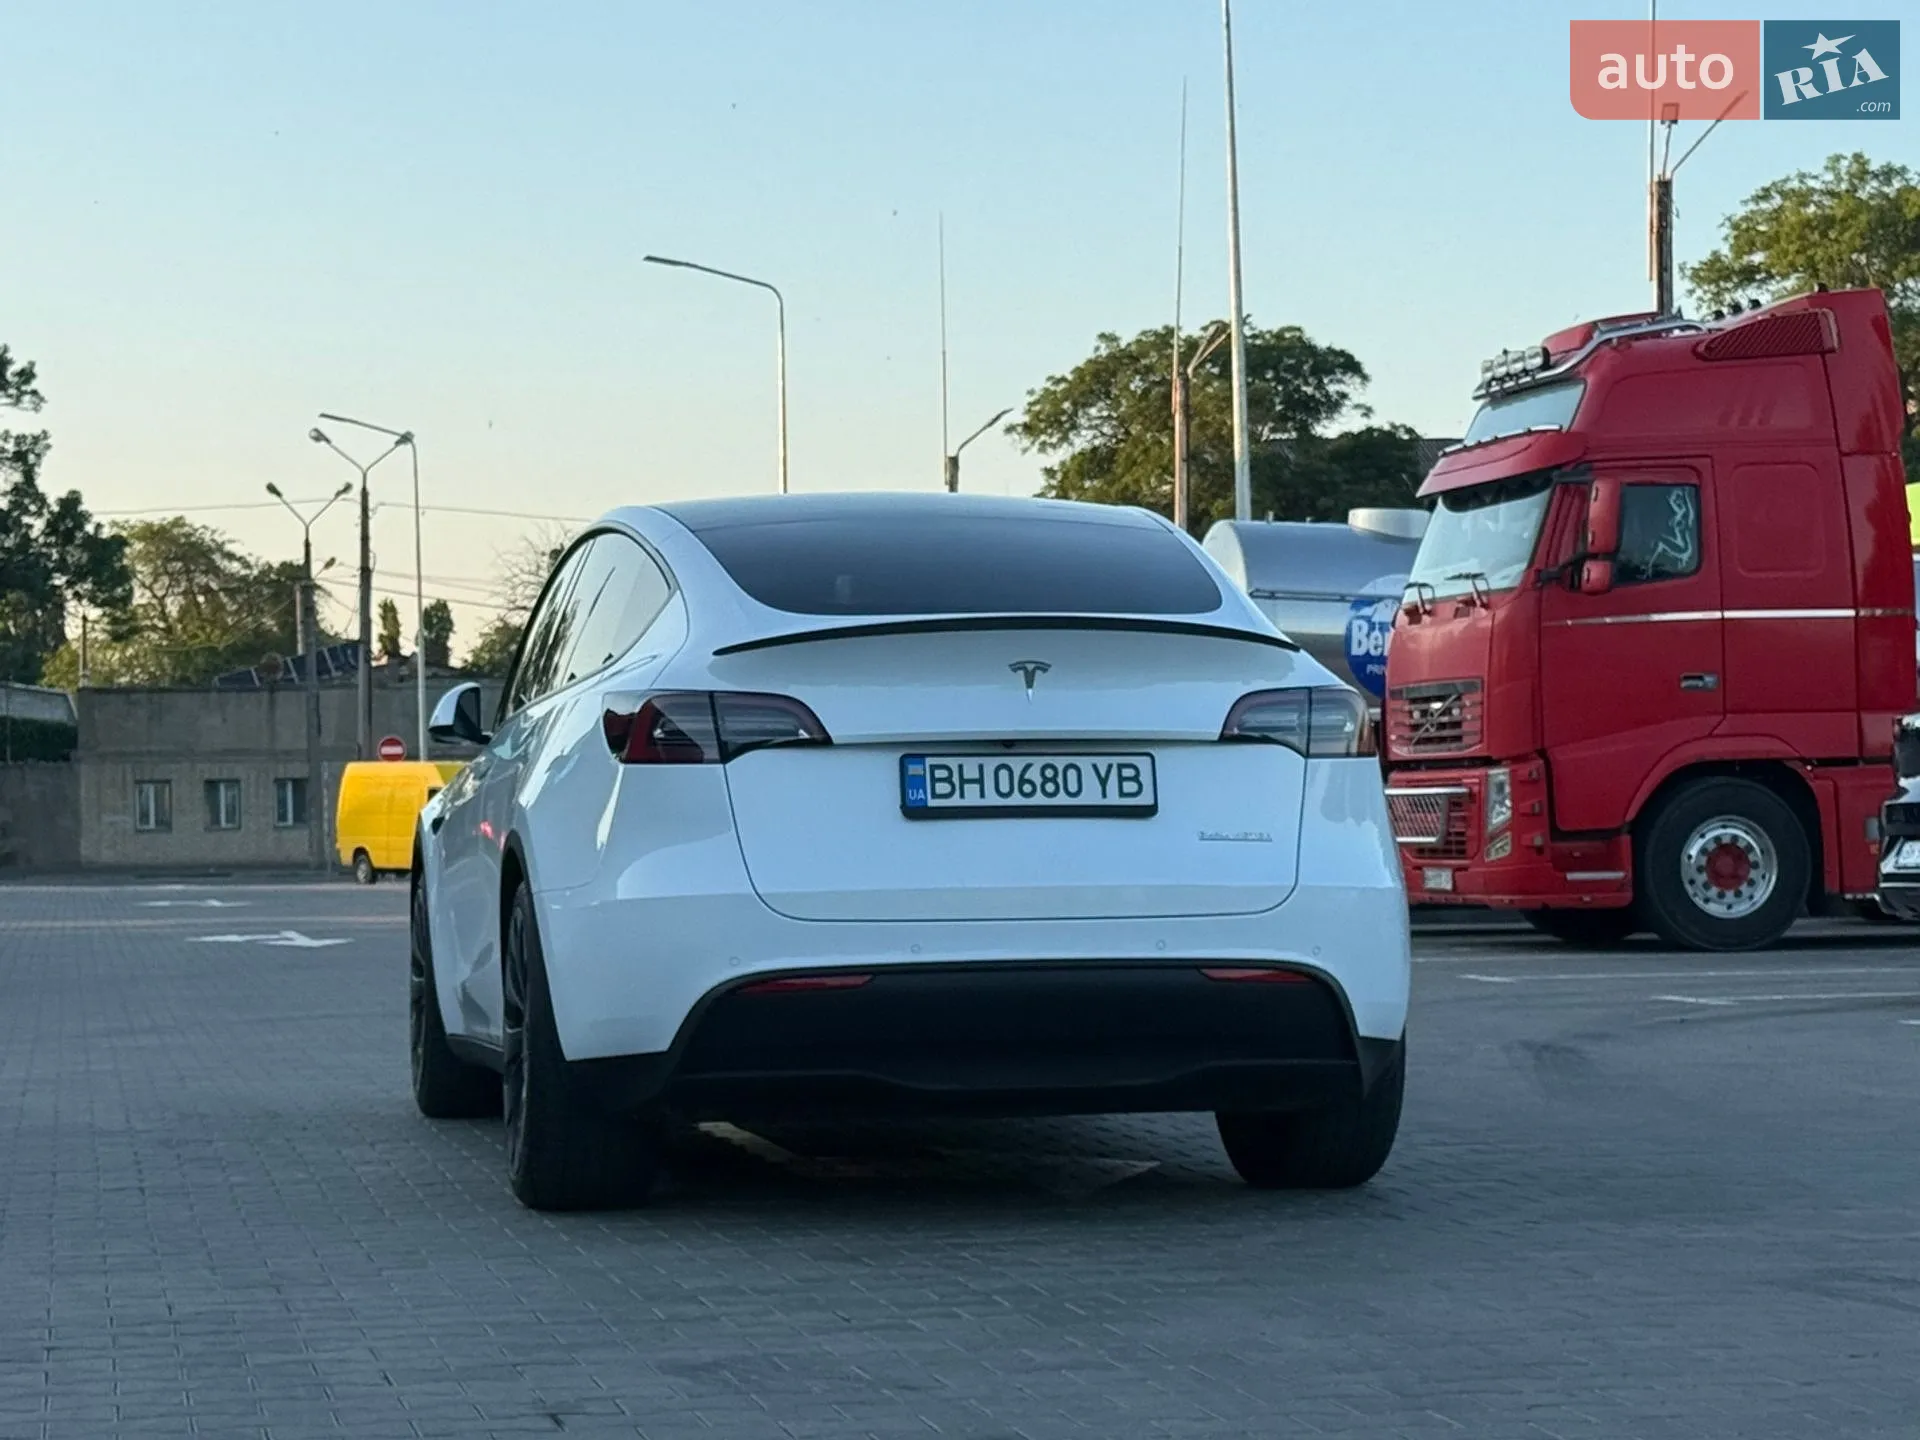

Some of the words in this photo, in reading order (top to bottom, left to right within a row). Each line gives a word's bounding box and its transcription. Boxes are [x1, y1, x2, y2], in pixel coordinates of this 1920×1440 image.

[929, 763, 985, 799] BH
[993, 763, 1083, 799] 0680
[1091, 763, 1143, 799] YB
[908, 788, 926, 801] UA
